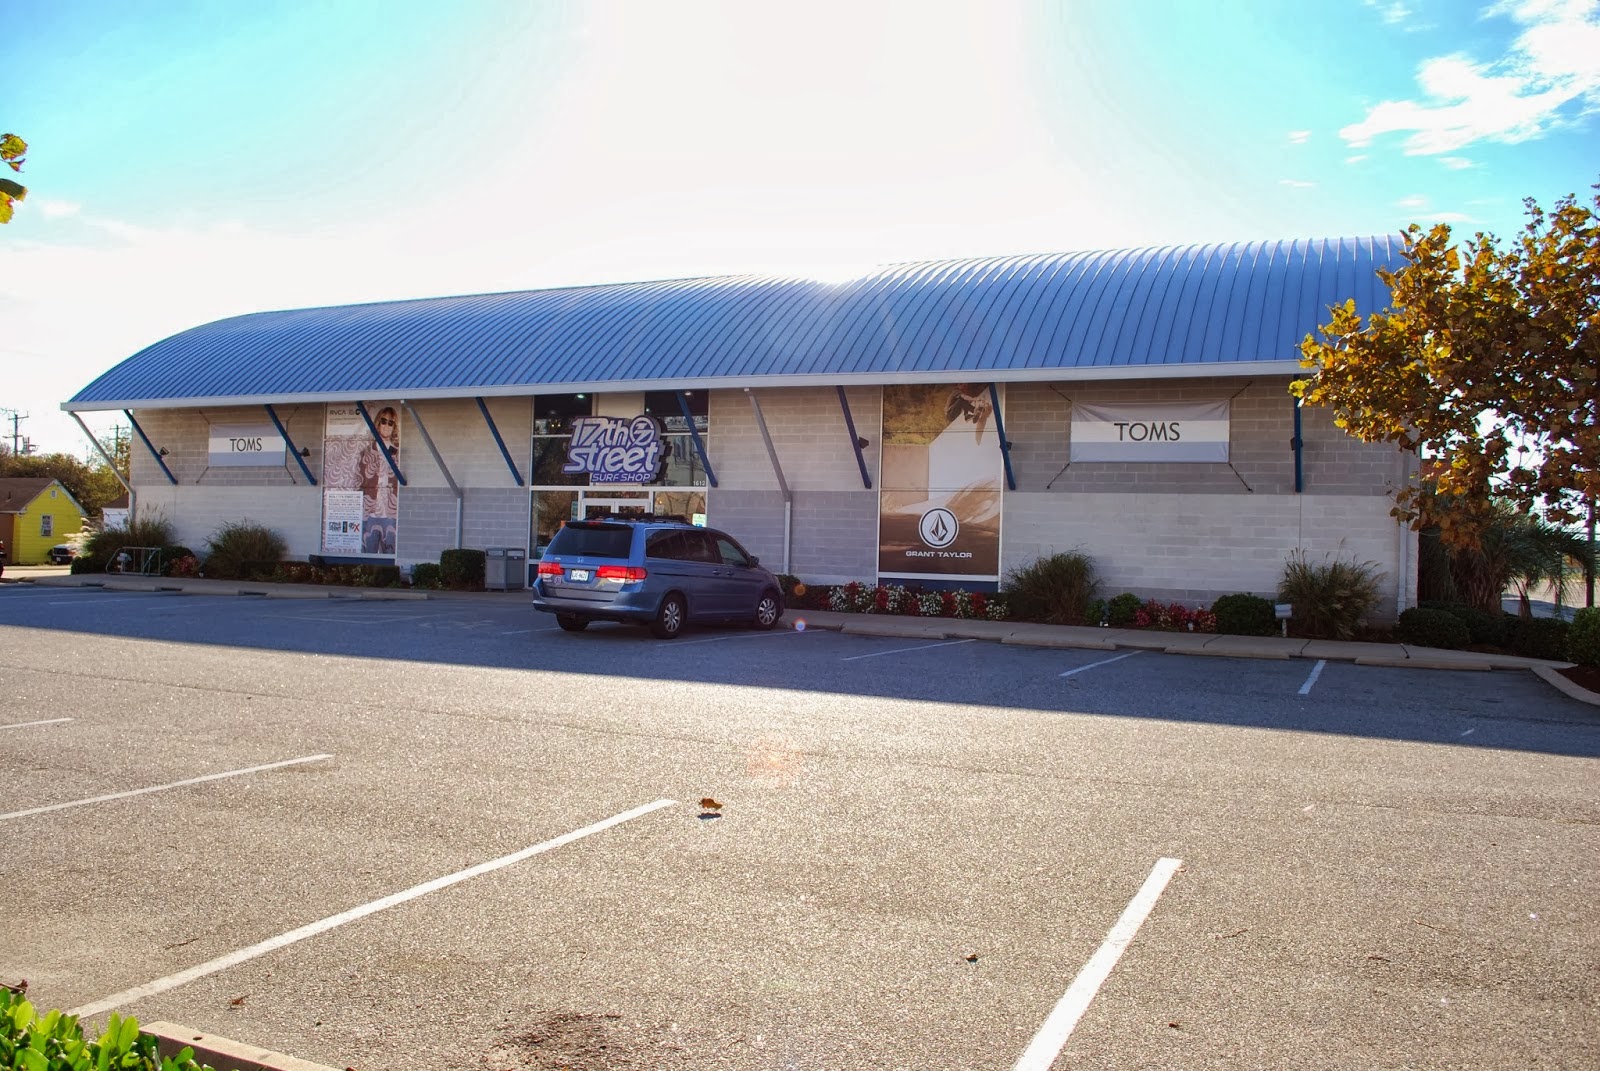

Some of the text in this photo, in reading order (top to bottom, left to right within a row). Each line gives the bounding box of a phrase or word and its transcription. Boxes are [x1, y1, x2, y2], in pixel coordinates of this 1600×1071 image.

[571, 418, 629, 448] 17th
[1113, 422, 1180, 441] TOMS
[229, 438, 262, 451] TOMS
[592, 473, 651, 482] SURF SHOP
